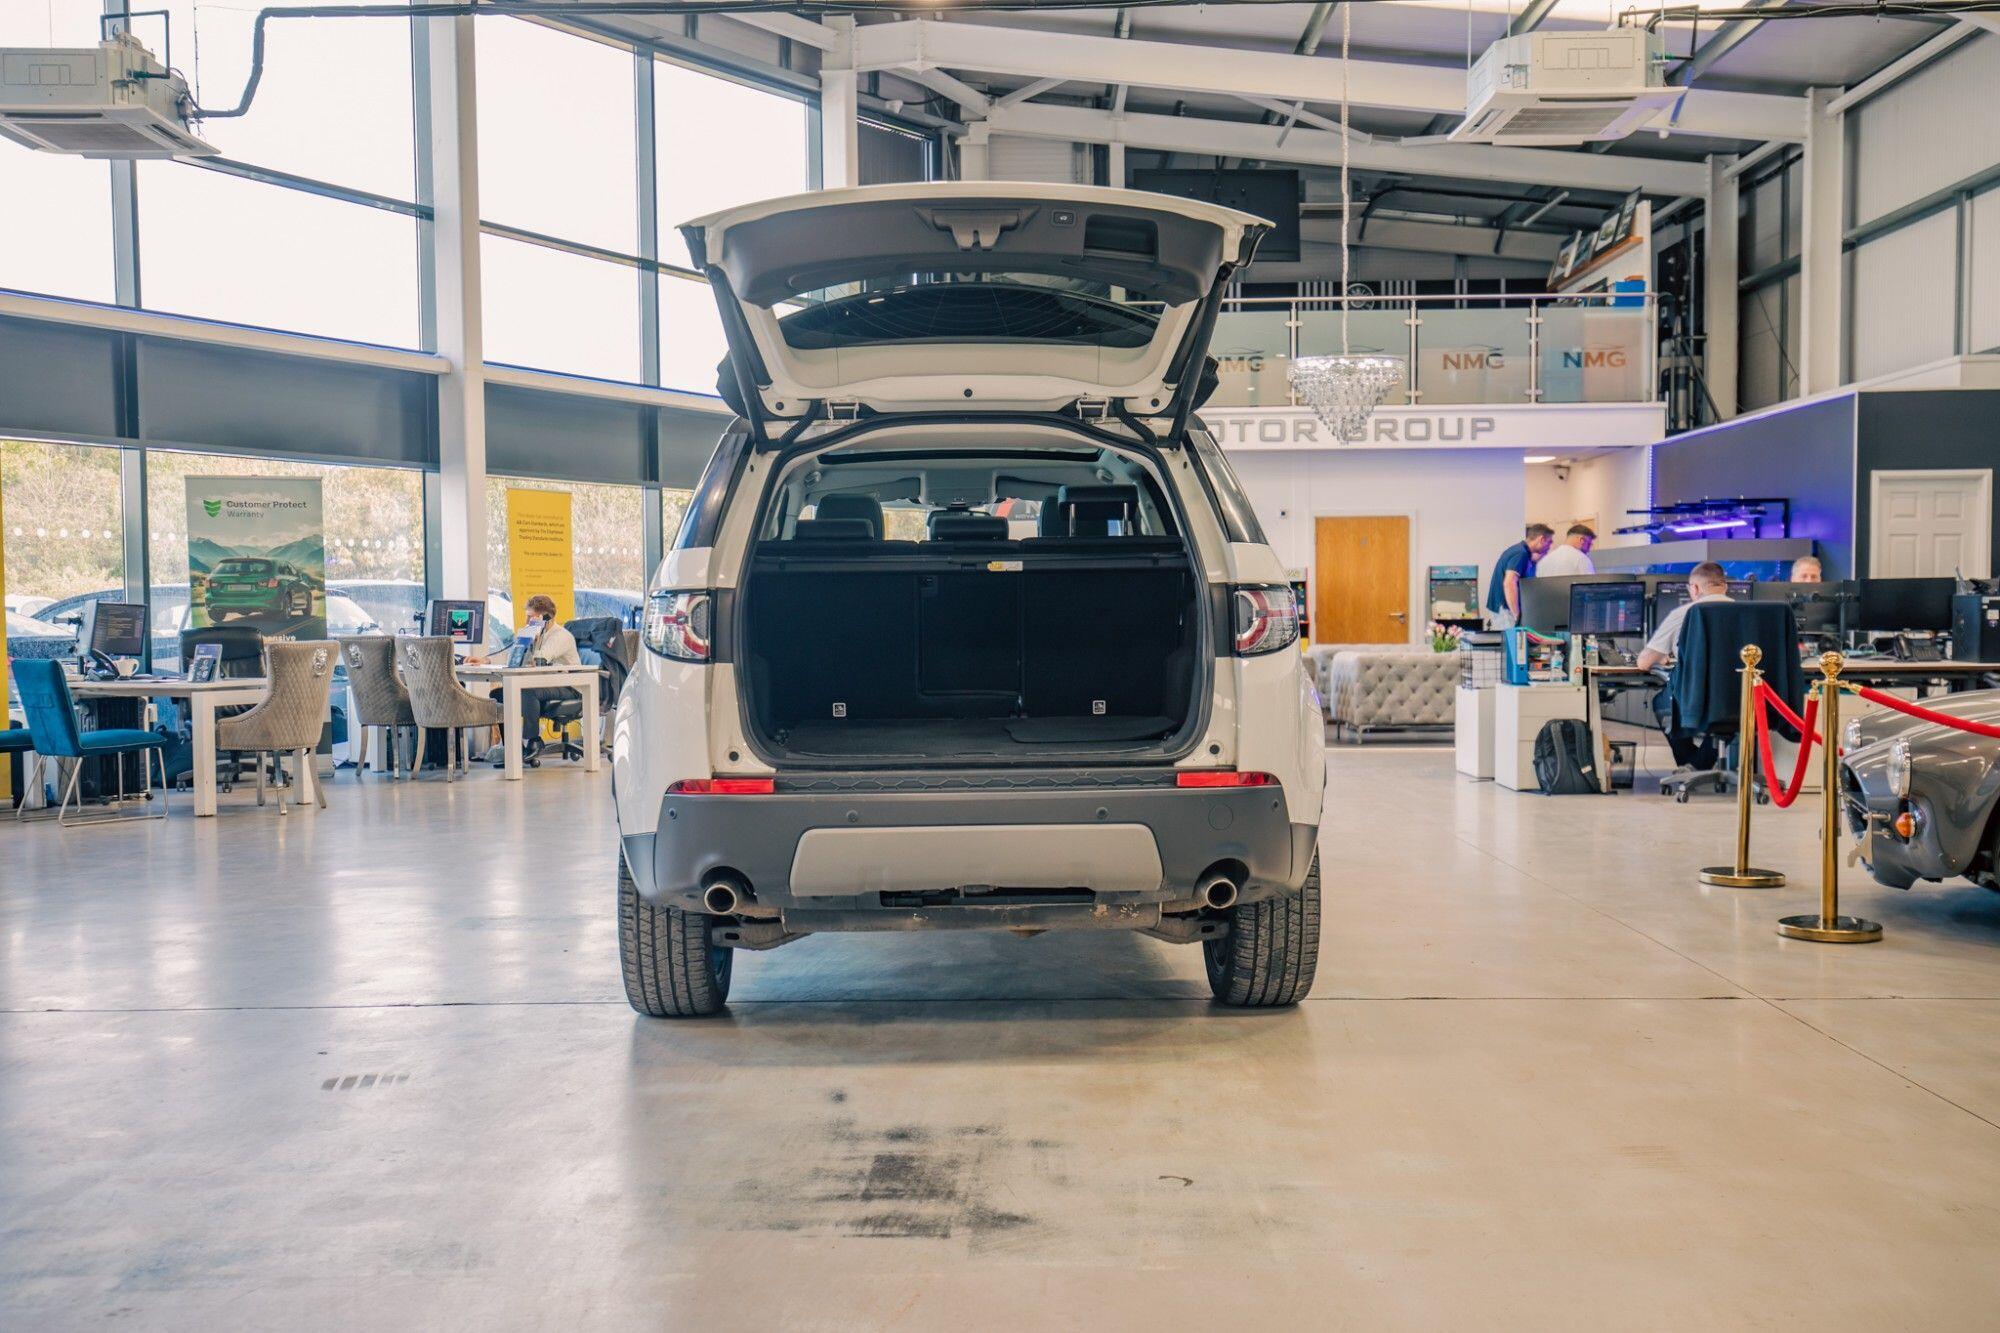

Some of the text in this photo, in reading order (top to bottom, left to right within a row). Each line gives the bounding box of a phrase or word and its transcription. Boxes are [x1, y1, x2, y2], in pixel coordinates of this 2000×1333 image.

[1442, 352, 1505, 370] NMG
[1563, 351, 1626, 368] NMG
[1206, 418, 1318, 443] OTOR
[226, 500, 308, 509] Customer Protect
[226, 510, 265, 519] Warranty
